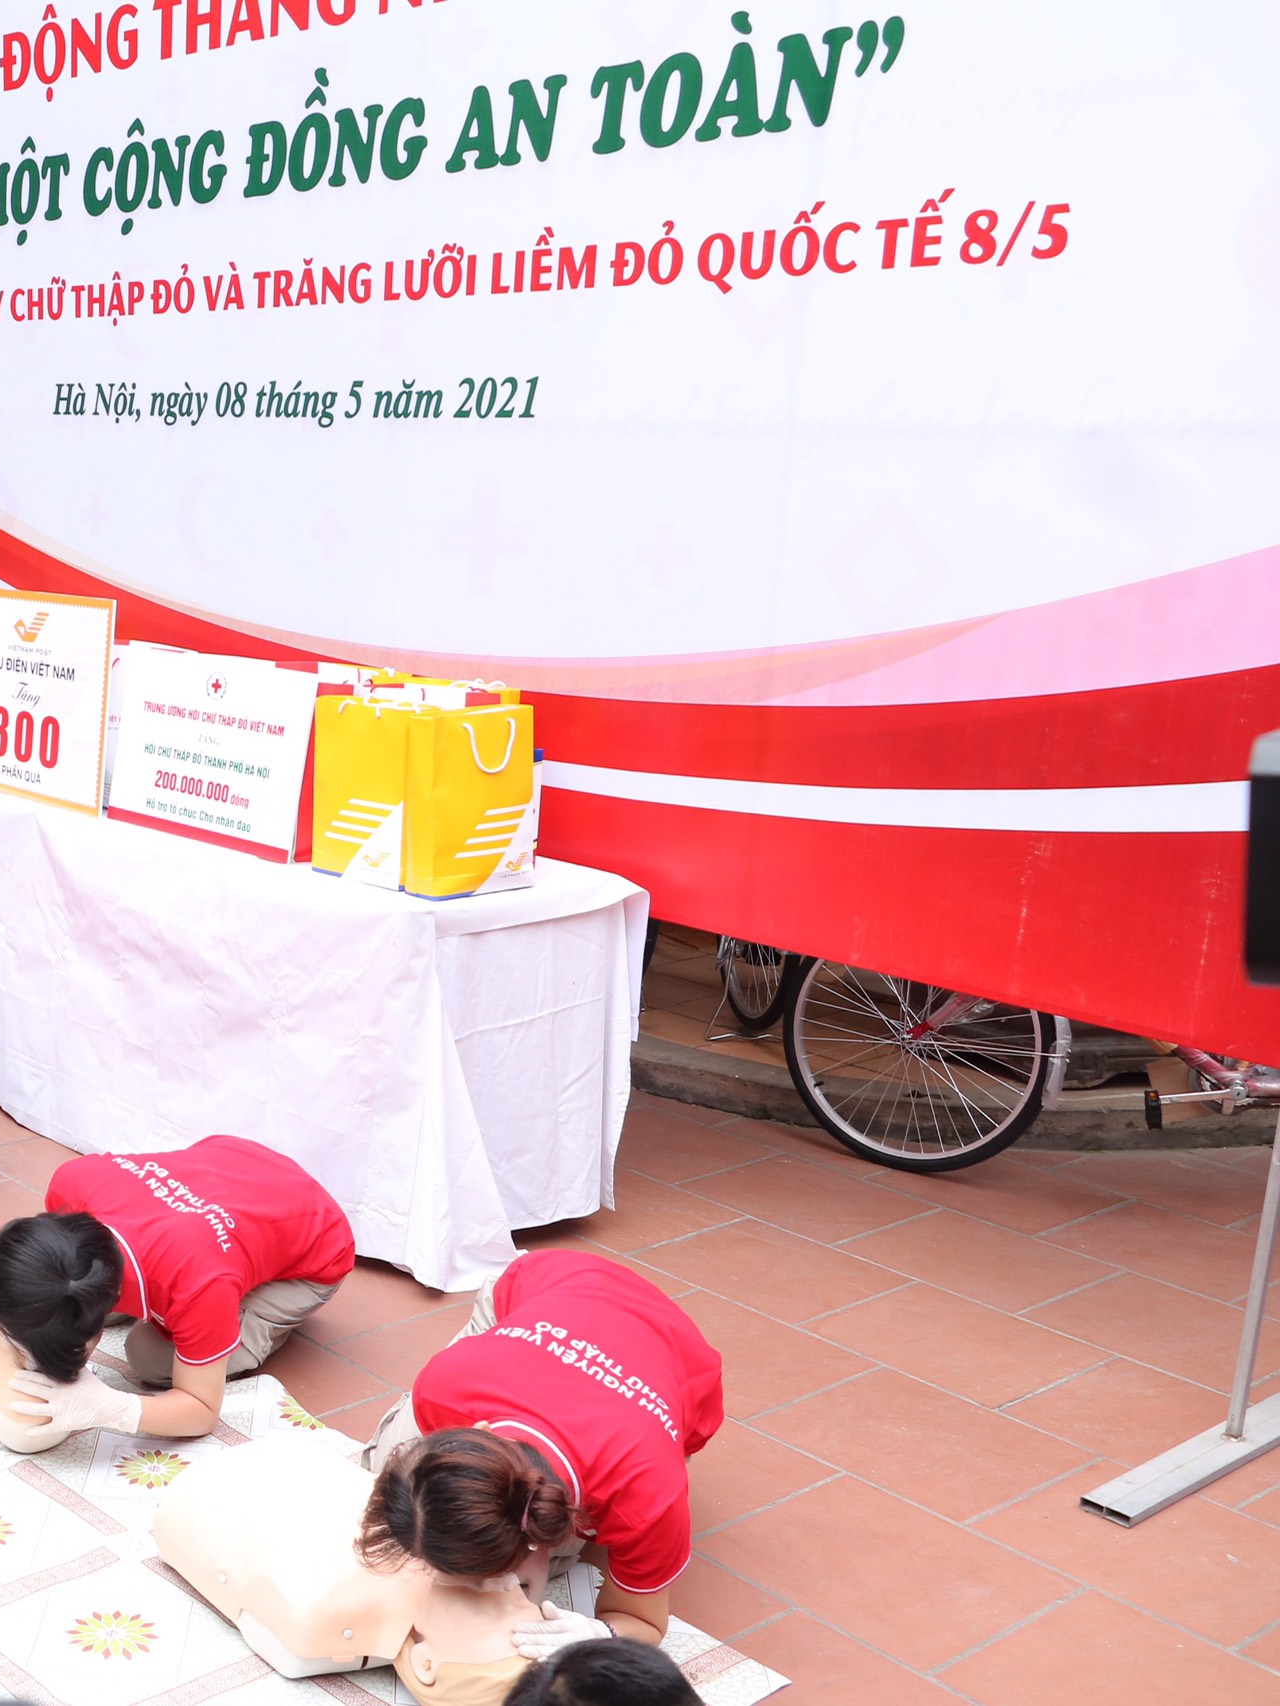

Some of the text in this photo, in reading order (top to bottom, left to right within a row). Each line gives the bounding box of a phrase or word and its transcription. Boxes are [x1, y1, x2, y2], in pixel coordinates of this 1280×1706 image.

[0, 3, 138, 102] ĐỘNG
[83, 118, 227, 235] CỘNG
[243, 68, 427, 198] ĐỒNG
[445, 74, 567, 173] AN
[10, 277, 67, 322] CHỮ
[71, 271, 144, 327] THẬP
[151, 263, 195, 315] ĐỎ
[204, 261, 245, 311] VÀ
[253, 258, 372, 309] TRĂNG
[384, 243, 477, 301] LƯỠI
[491, 227, 597, 294] LIỀM
[611, 220, 684, 288] ĐỎ
[698, 201, 861, 294] QUỐC
[876, 188, 955, 269] TẾ
[960, 201, 1070, 267] 8/5
[52, 376, 539, 428] Hà Nội, ngày 08 tháng 5 năm 2021
[6, 656, 28, 674] ĐIỆN
[30, 660, 51, 678] VIỆT
[52, 665, 75, 682] NAM
[8, 644, 52, 657] VIETNAM POST
[144, 700, 166, 715] TRUNG
[266, 724, 285, 736] NAM
[154, 770, 230, 803] 200.000.000
[112, 1157, 146, 1179] VIÊN
[143, 1162, 169, 1178] ĐỎ
[167, 1178, 205, 1207] THẬP
[205, 1214, 231, 1252] TÌNH
[535, 1321, 669, 1410] CHỮ THẬP ĐỎ
[494, 1327, 678, 1442] TÌNH NGUYỆN VIÊN
